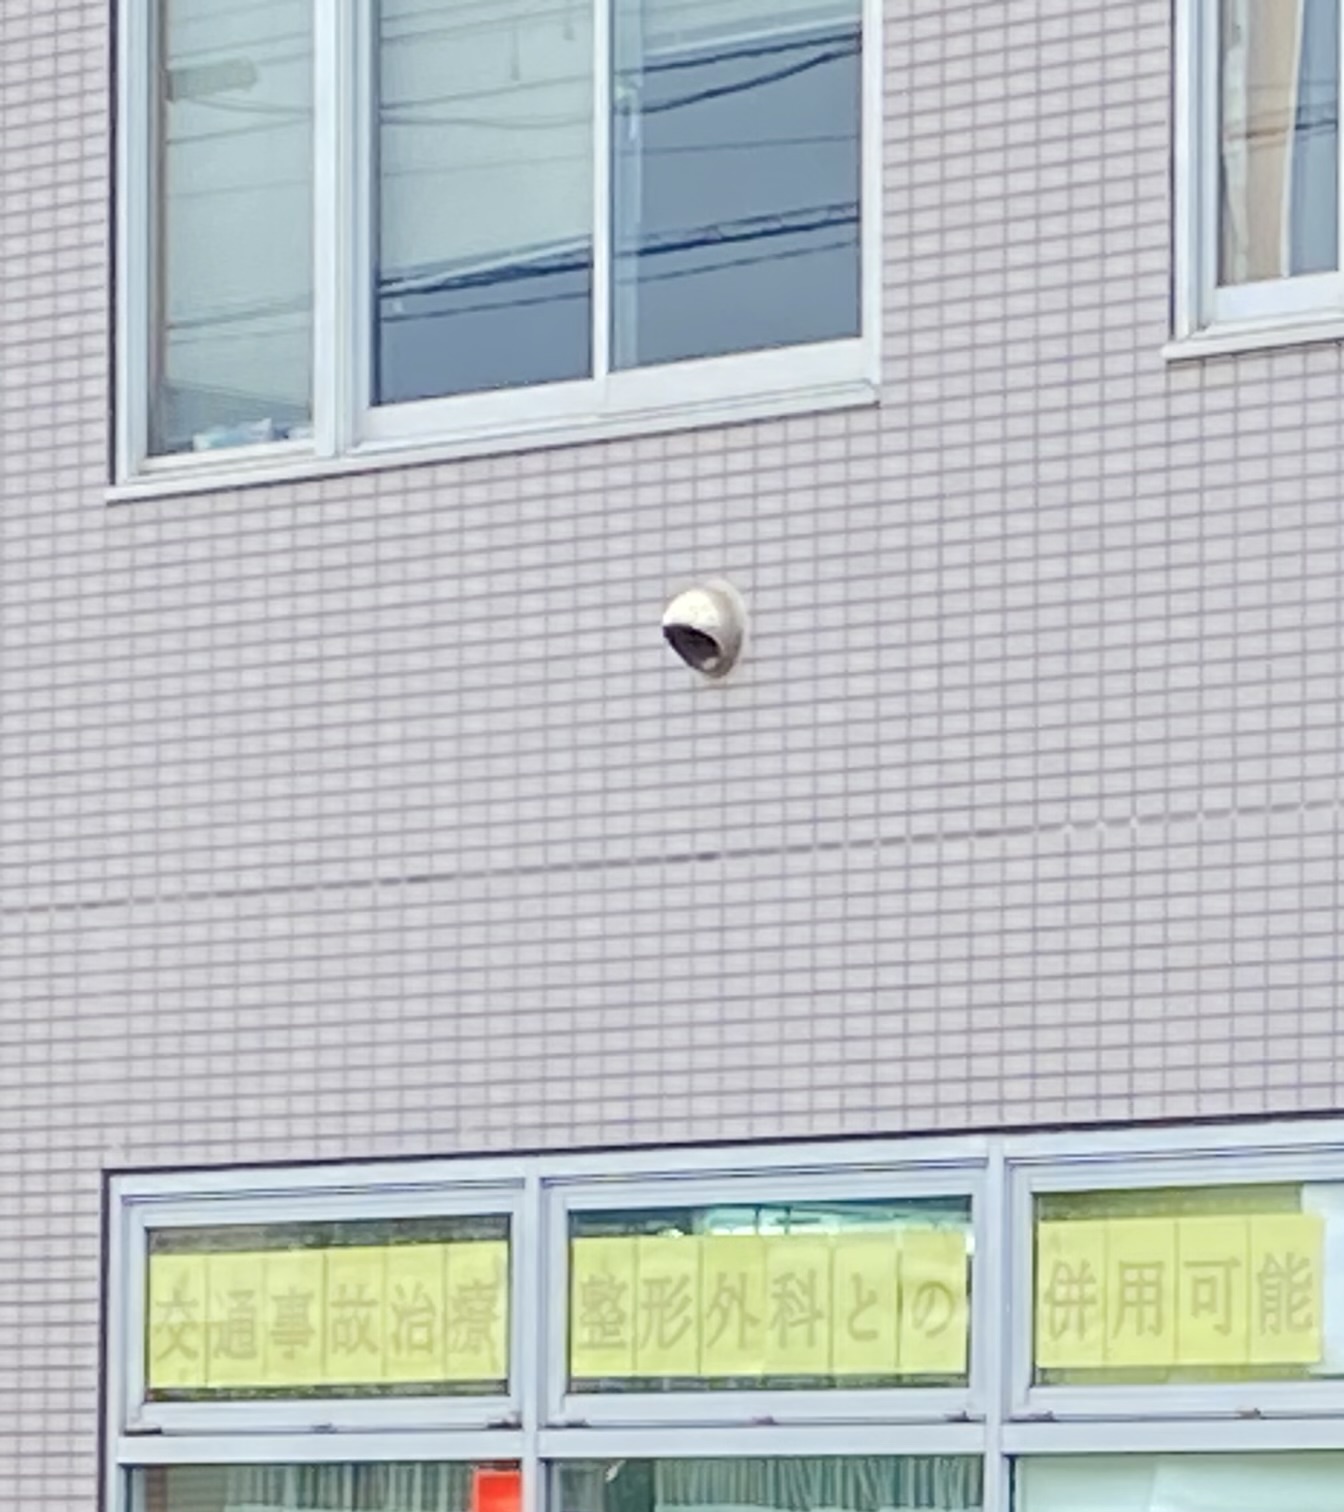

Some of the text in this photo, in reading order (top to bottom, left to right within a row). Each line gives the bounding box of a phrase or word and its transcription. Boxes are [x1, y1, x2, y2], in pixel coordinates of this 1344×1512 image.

[155, 1250, 1314, 1366] 交通事故治療 整形外科との 併用可能
